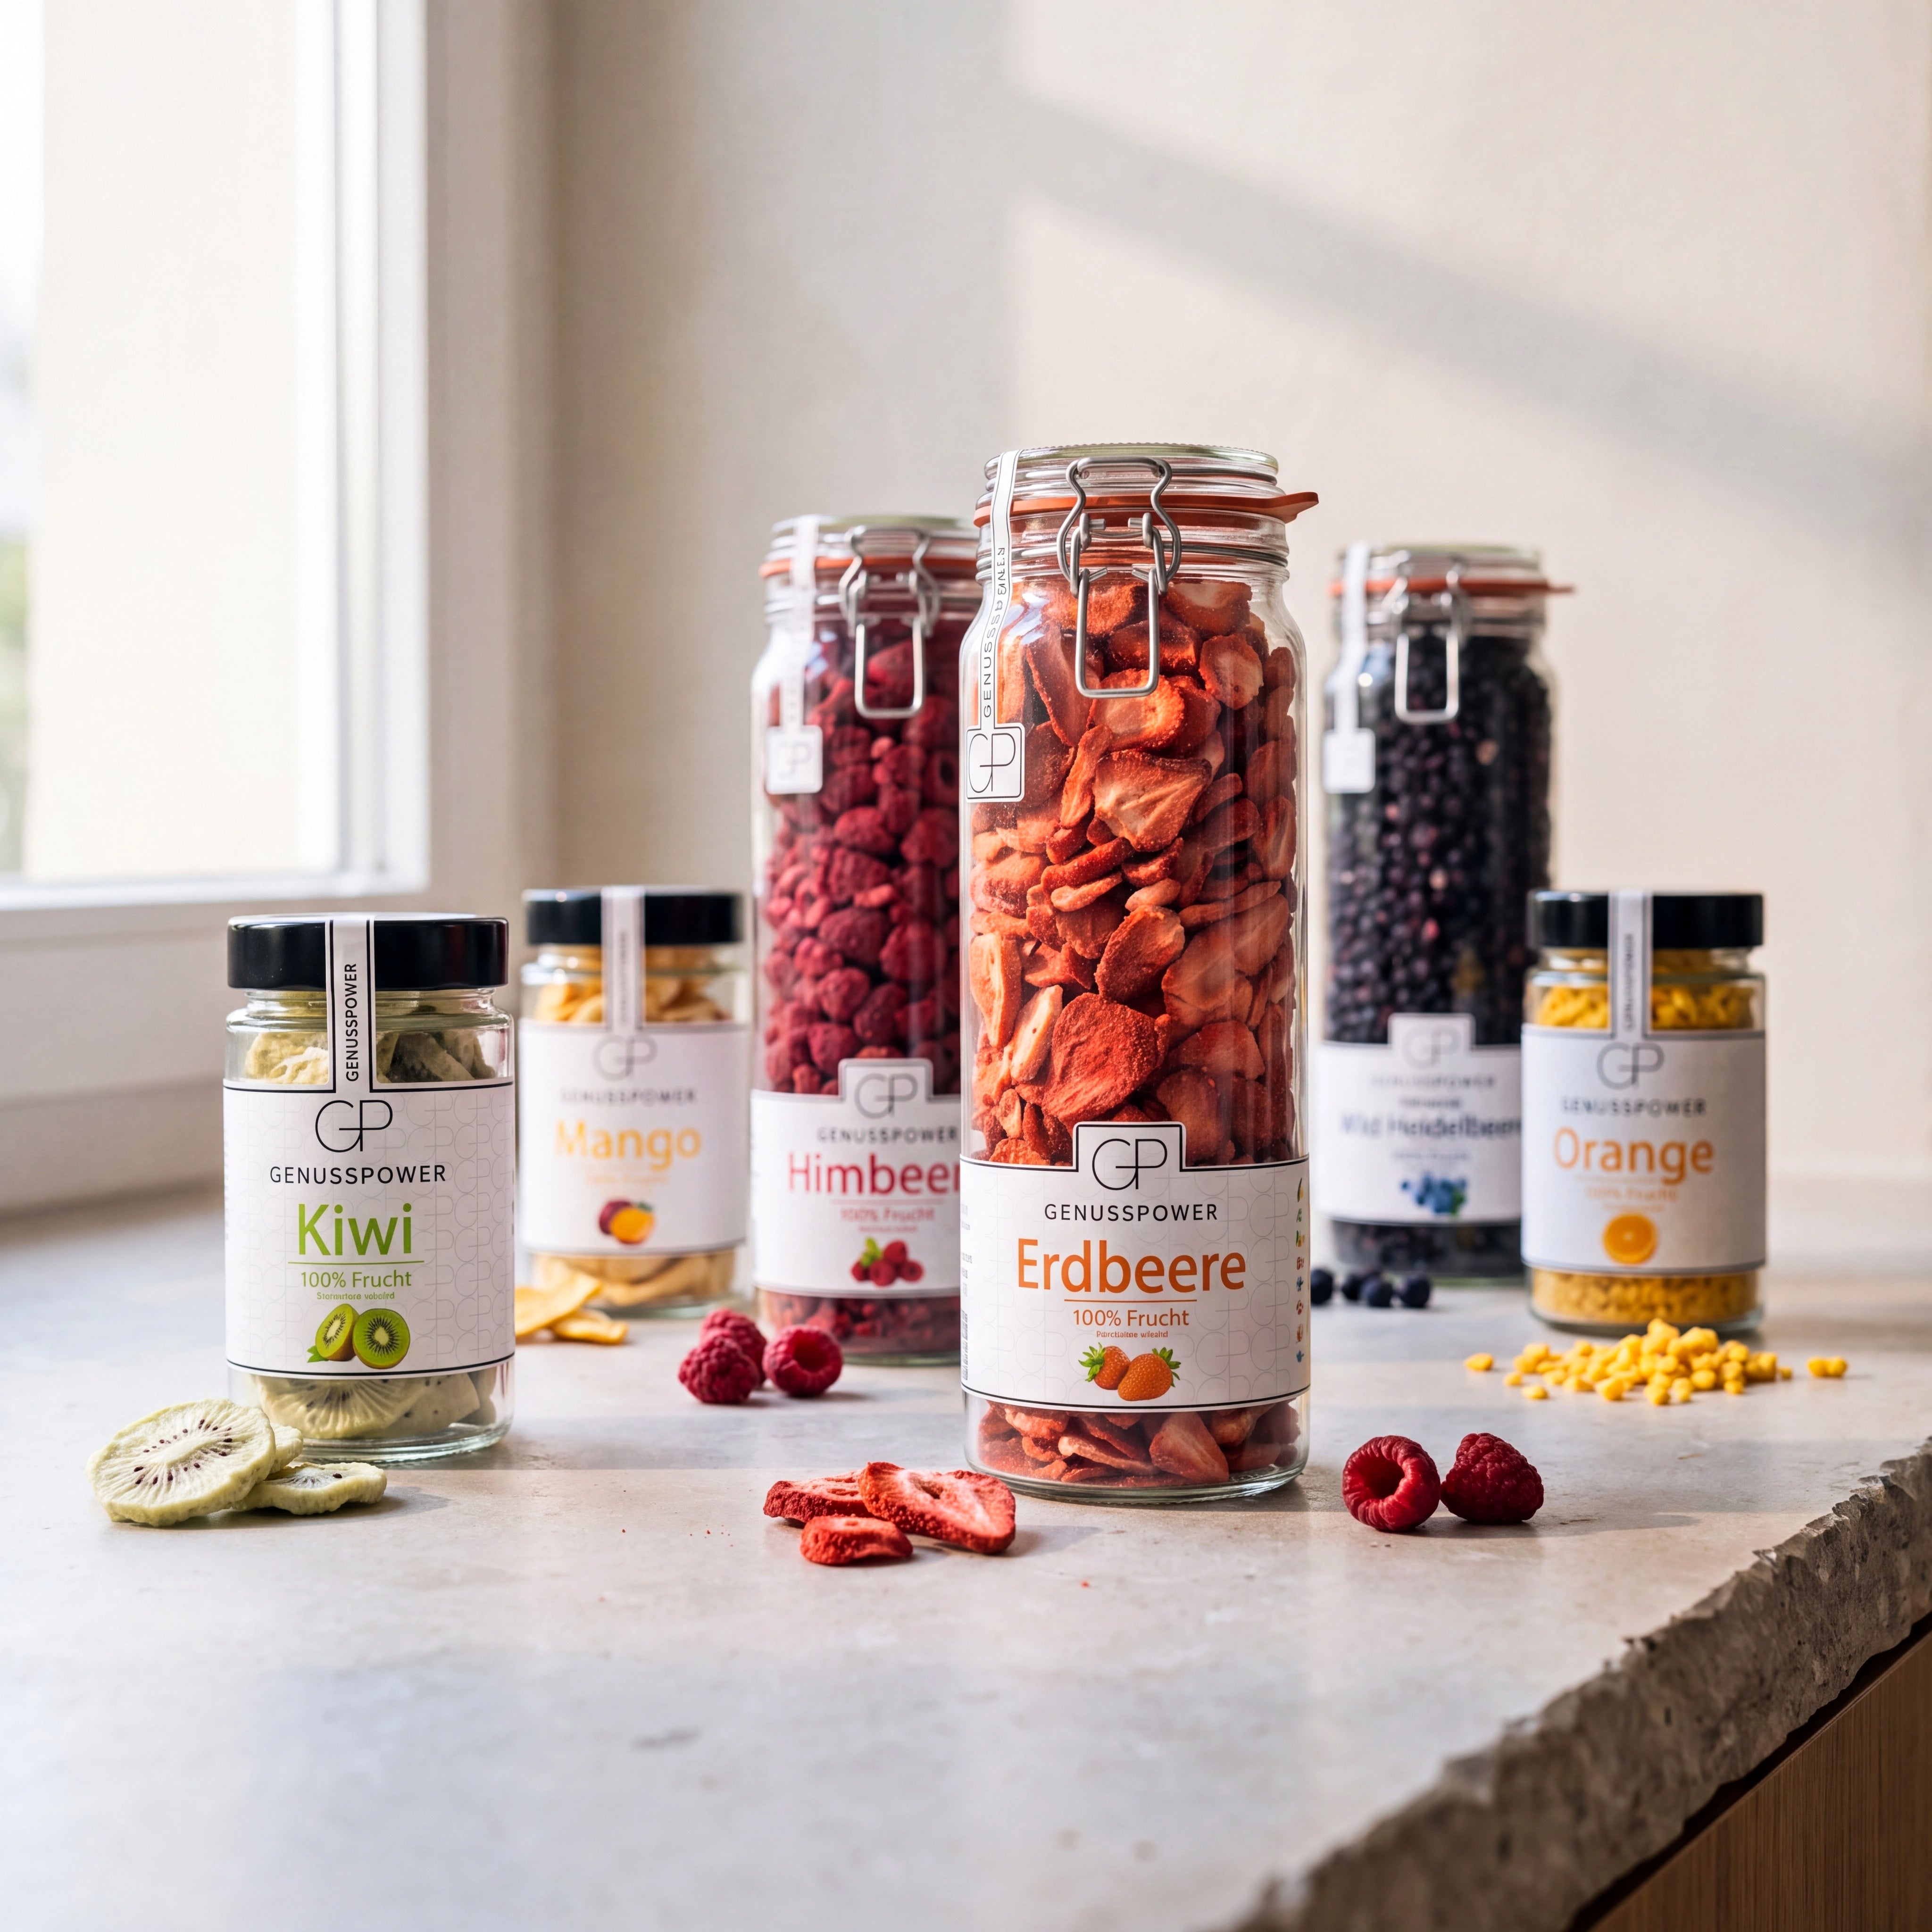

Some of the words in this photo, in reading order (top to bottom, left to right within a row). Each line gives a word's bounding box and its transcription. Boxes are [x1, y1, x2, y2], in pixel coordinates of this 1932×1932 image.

[969, 733, 1016, 793] GP
[345, 964, 358, 1082] GENUSSPOWER
[1596, 1041, 1665, 1090] GP
[854, 1073, 918, 1120] GP
[315, 1100, 393, 1152] GP
[556, 1120, 701, 1171] Mango
[818, 1125, 958, 1144] GENUSSPOWER
[270, 1165, 446, 1184] GENUSSPOWER
[1092, 1138, 1168, 1191] GP
[1555, 1127, 1714, 1185] Orange
[298, 1203, 412, 1256] Kiwi
[1044, 1203, 1217, 1222] GENUSSPOWER
[301, 1272, 346, 1288] 100%
[352, 1269, 412, 1288] Frucht
[1018, 1238, 1246, 1293] Erdbeere
[1073, 1309, 1121, 1326] 100%
[1127, 1308, 1189, 1326] Frucht
